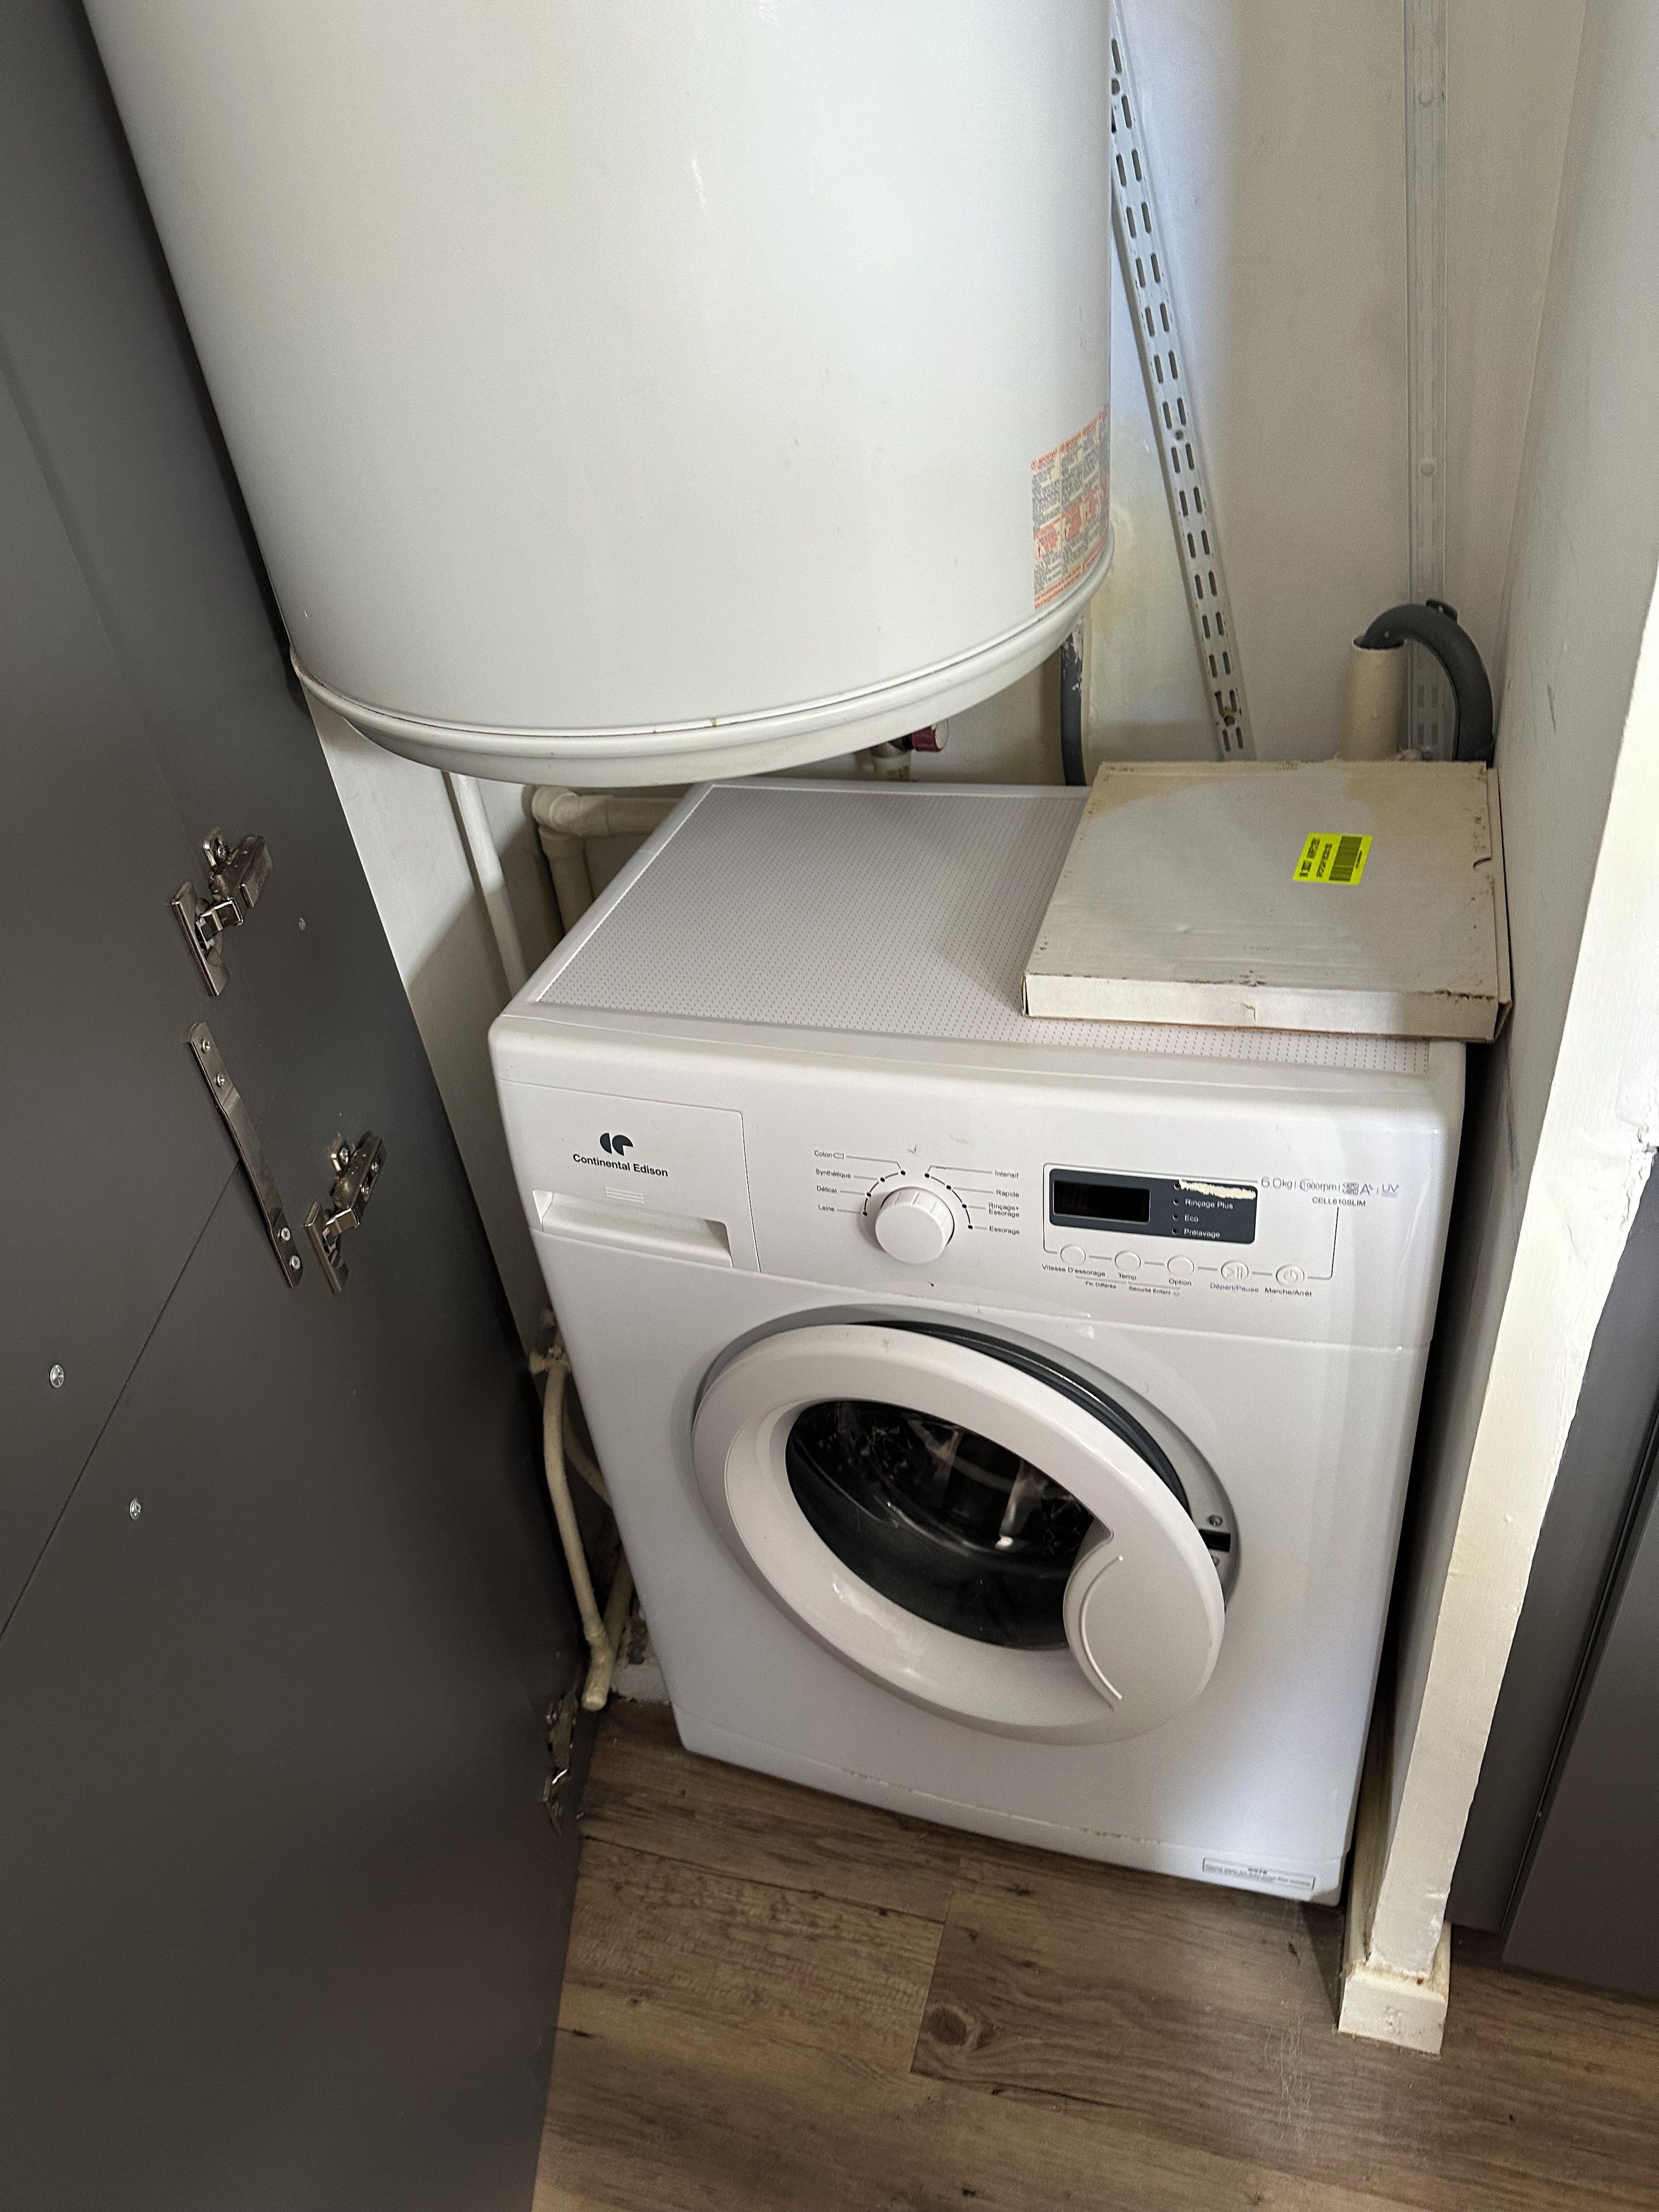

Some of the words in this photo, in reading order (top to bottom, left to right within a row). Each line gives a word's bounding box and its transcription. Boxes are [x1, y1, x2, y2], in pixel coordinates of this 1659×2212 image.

[573, 1153, 630, 1171] Continental
[633, 1163, 668, 1177] Edison
[995, 1169, 1019, 1179] Intensif
[995, 1189, 1020, 1198] Rapide
[818, 1204, 835, 1213] Laine
[1184, 1198, 1215, 1209] Rinçage
[1217, 1200, 1234, 1210] Plus
[988, 1209, 1020, 1218] Essorage
[1184, 1214, 1199, 1223] Eco
[989, 1225, 1020, 1236] Essorage
[1183, 1228, 1221, 1238] Prélavage
[1041, 1263, 1066, 1272] Vitesse
[1118, 1272, 1137, 1281] Temp
[1168, 1278, 1192, 1287] Option
[1209, 1282, 1259, 1293] Départ/Pause
[1264, 1286, 1312, 1297] Marche/Arrêt
